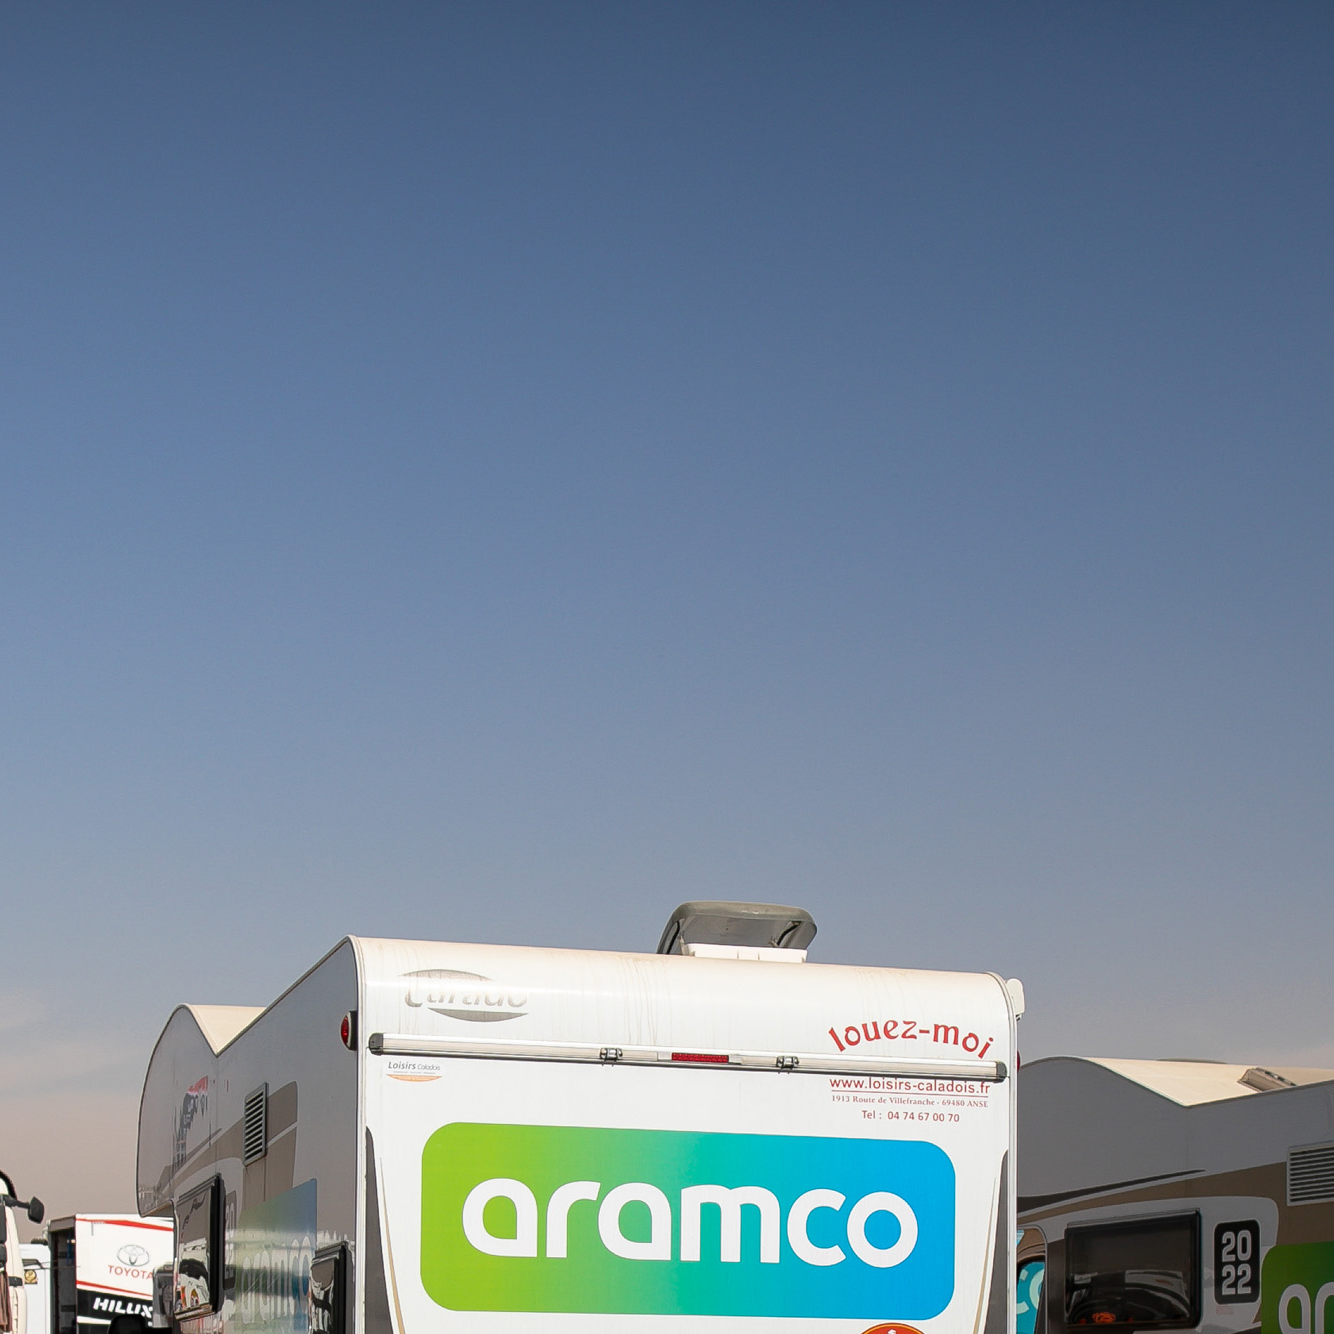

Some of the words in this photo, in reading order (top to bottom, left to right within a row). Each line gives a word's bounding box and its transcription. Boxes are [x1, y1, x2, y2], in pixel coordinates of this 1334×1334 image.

[829, 1019, 994, 1059] louez-moi
[388, 1061, 416, 1070] Loisirs
[829, 1077, 991, 1094] www.loisirs-caladois.fr
[832, 1095, 850, 1103] 1913
[853, 1096, 875, 1104] Route
[878, 1096, 887, 1104] de
[889, 1097, 935, 1106] Villefranche
[941, 1099, 965, 1107] 69480
[967, 1100, 989, 1108] ANSE
[862, 1110, 876, 1119] Tel
[887, 1111, 900, 1120] 04
[903, 1112, 915, 1120] 74
[918, 1112, 930, 1121] 67
[932, 1113, 945, 1121] 00
[948, 1113, 960, 1122] 70
[462, 1178, 919, 1268] aramco
[1222, 1229, 1252, 1262] 20
[108, 1265, 153, 1280] TOYOTA
[1222, 1263, 1252, 1295] 22
[93, 1297, 153, 1318] HILUX
